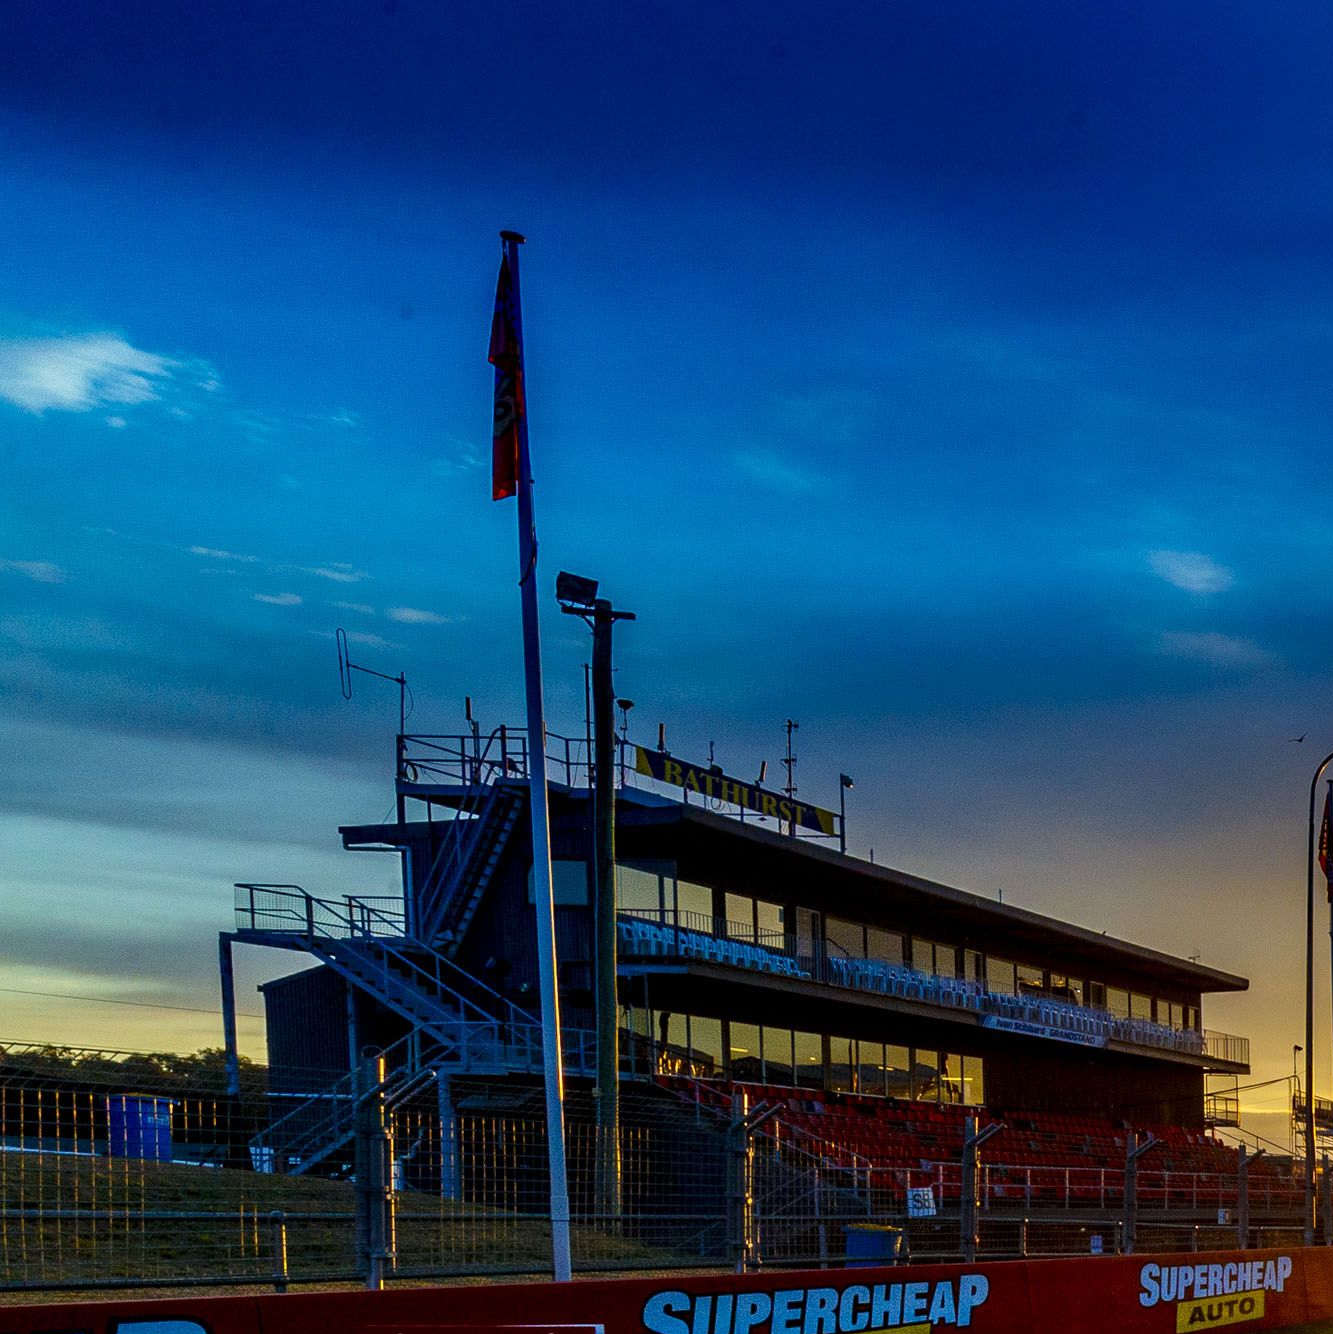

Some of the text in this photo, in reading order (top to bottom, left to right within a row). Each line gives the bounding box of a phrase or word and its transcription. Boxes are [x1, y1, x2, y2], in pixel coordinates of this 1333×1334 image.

[663, 758, 808, 827] BATHURST
[1139, 1255, 1293, 1308] SUPERCHEAP
[1188, 1296, 1256, 1326] AUTO
